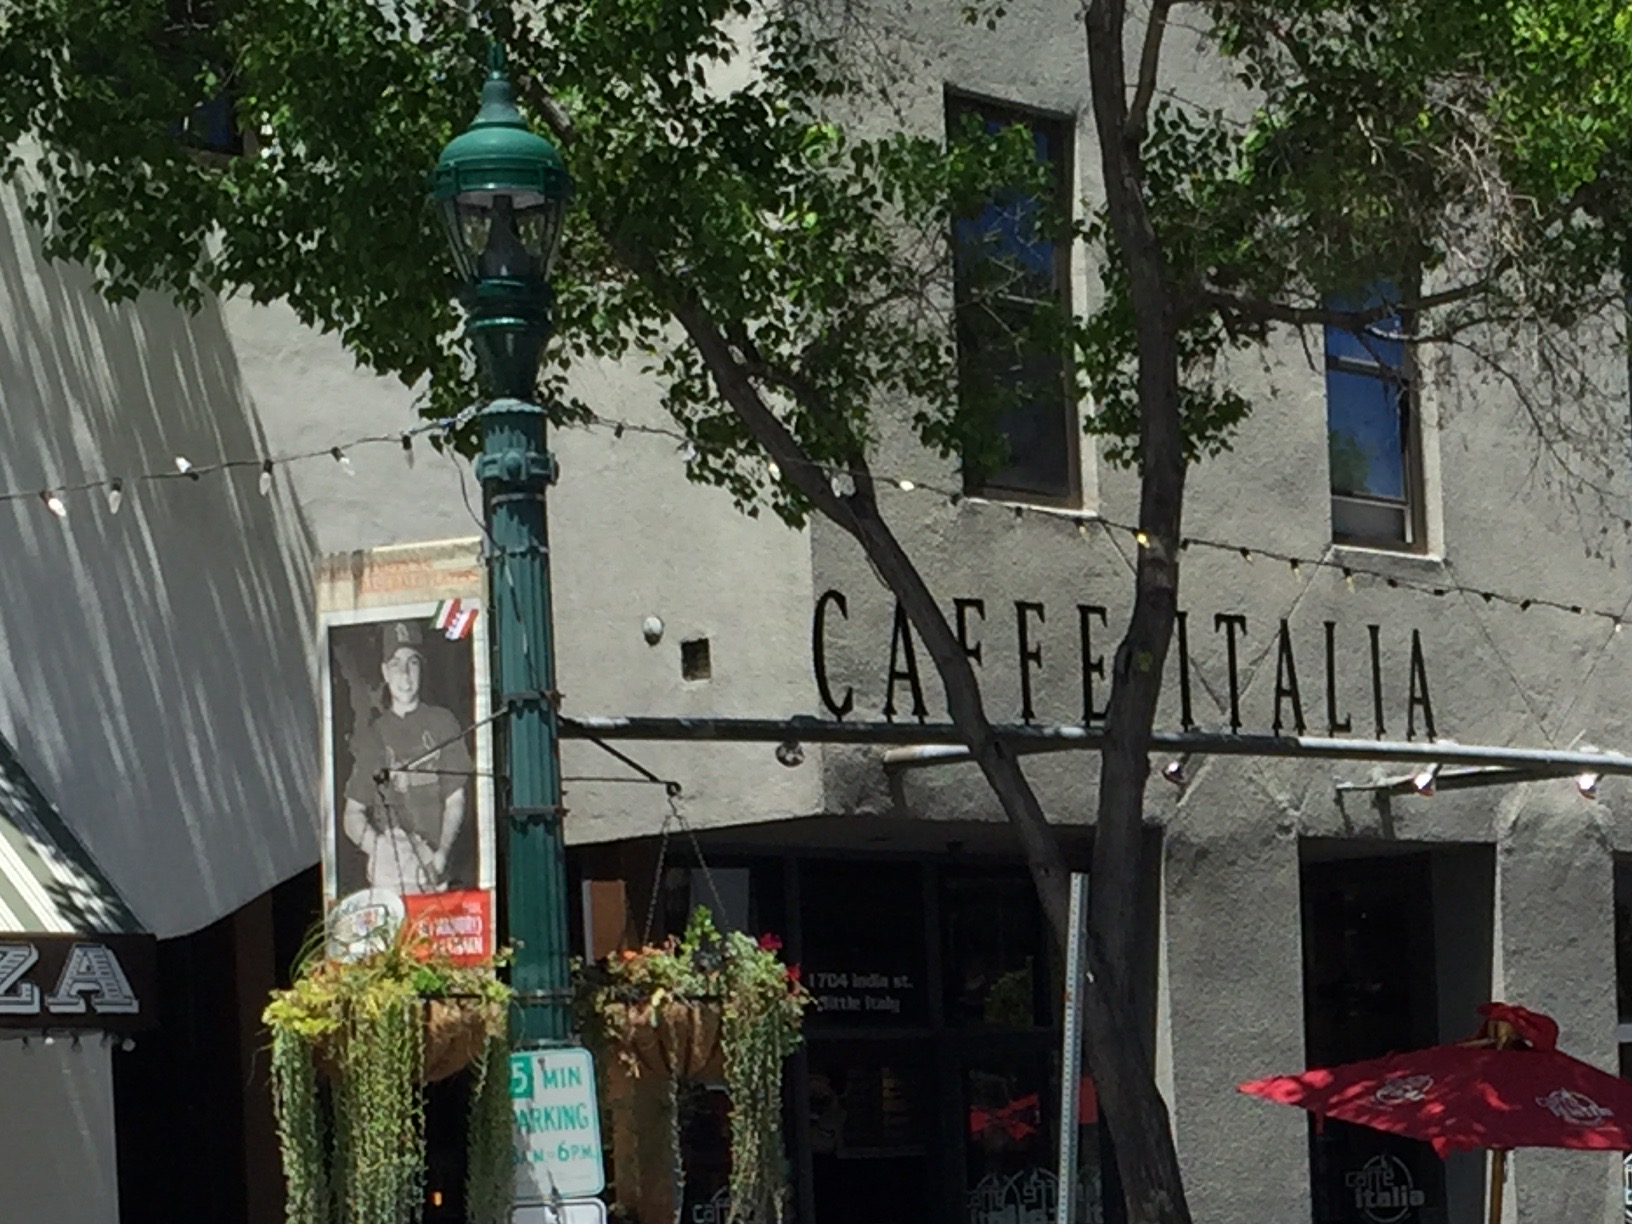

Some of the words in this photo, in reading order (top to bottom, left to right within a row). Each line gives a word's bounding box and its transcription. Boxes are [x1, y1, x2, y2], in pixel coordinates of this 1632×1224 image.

[813, 590, 1107, 727] CAFFE
[1174, 611, 1437, 742] ITALIA
[543, 1066, 581, 1089] MIN
[513, 1103, 589, 1134] ARKING
[1356, 1185, 1425, 1208] italia
